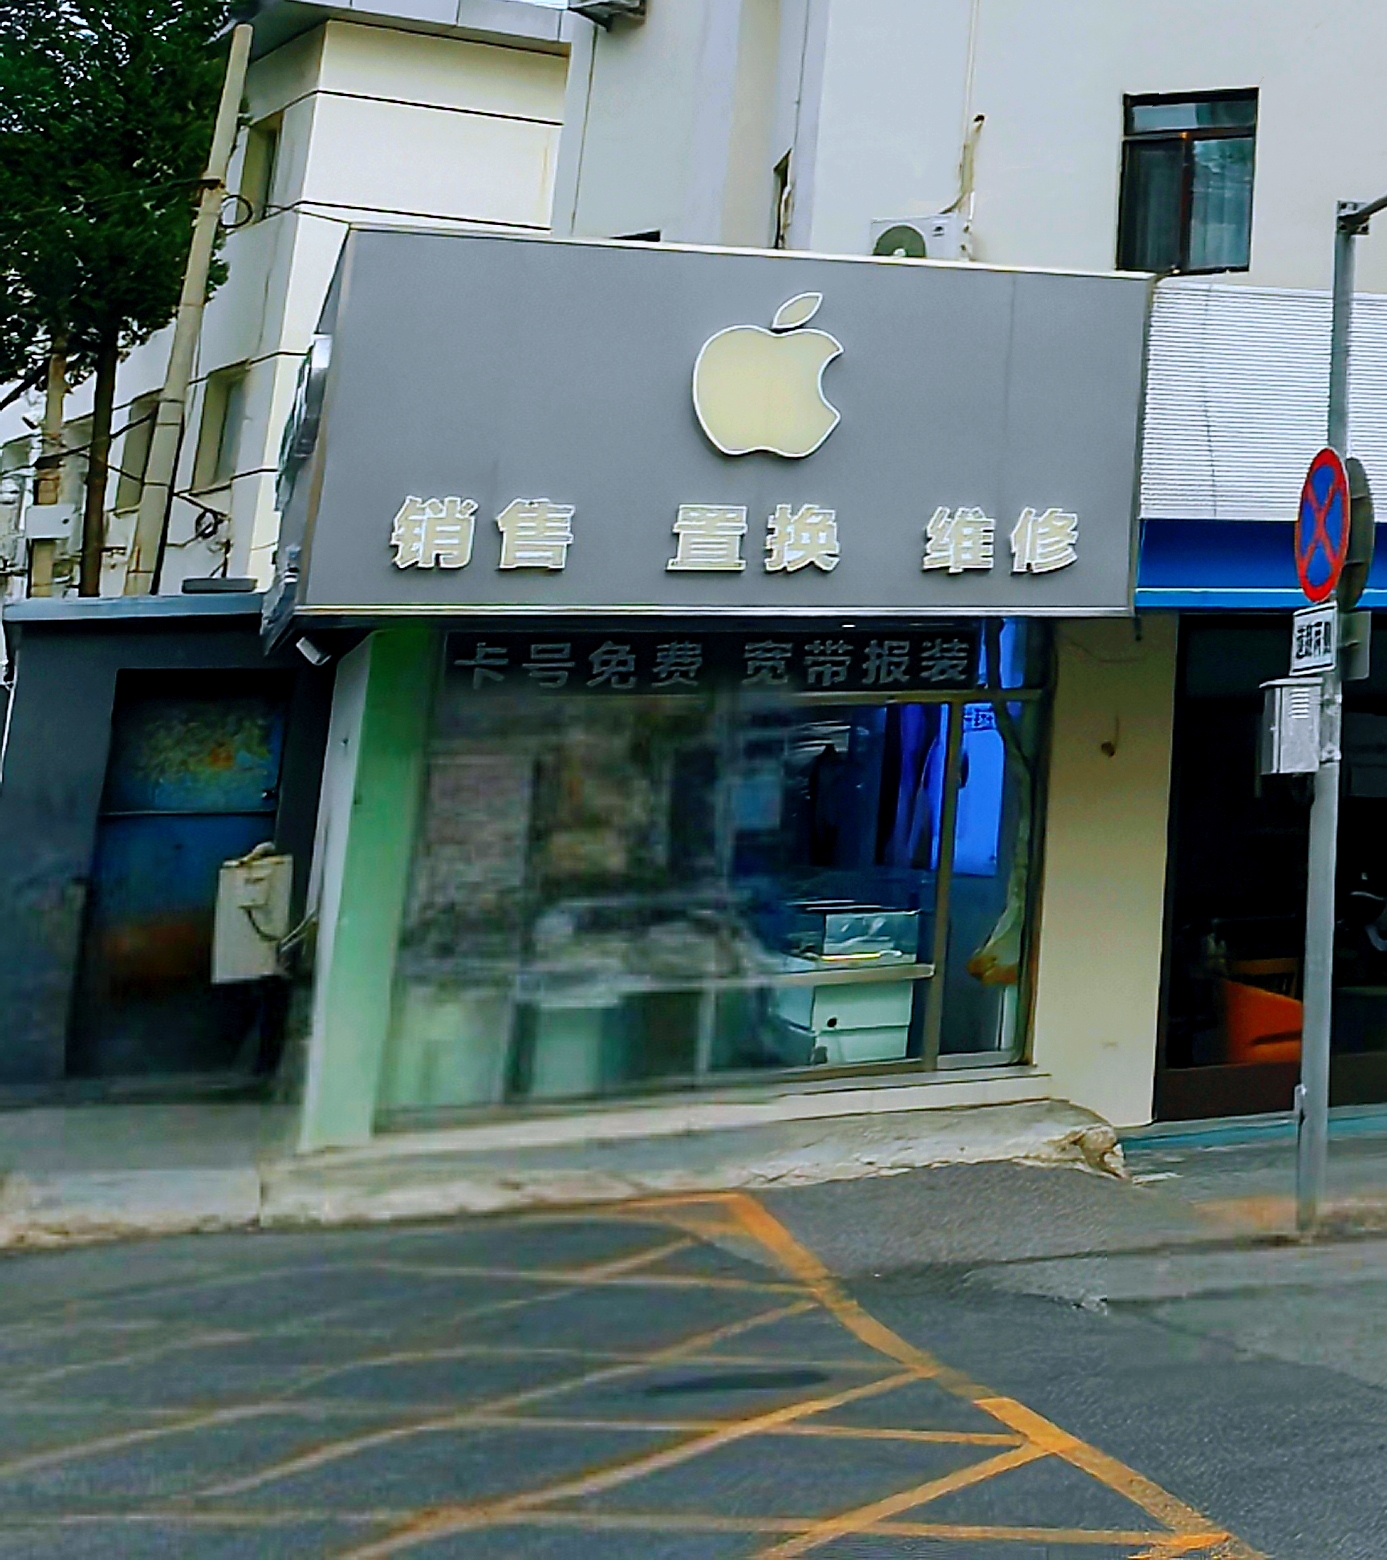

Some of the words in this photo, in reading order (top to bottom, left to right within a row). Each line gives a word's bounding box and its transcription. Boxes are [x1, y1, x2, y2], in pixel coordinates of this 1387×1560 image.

[391, 495, 575, 570] 销售
[665, 504, 840, 572] 置换
[922, 506, 1078, 573] 维修
[455, 641, 702, 689] 卡号免费
[742, 639, 970, 687] 宽带报装
